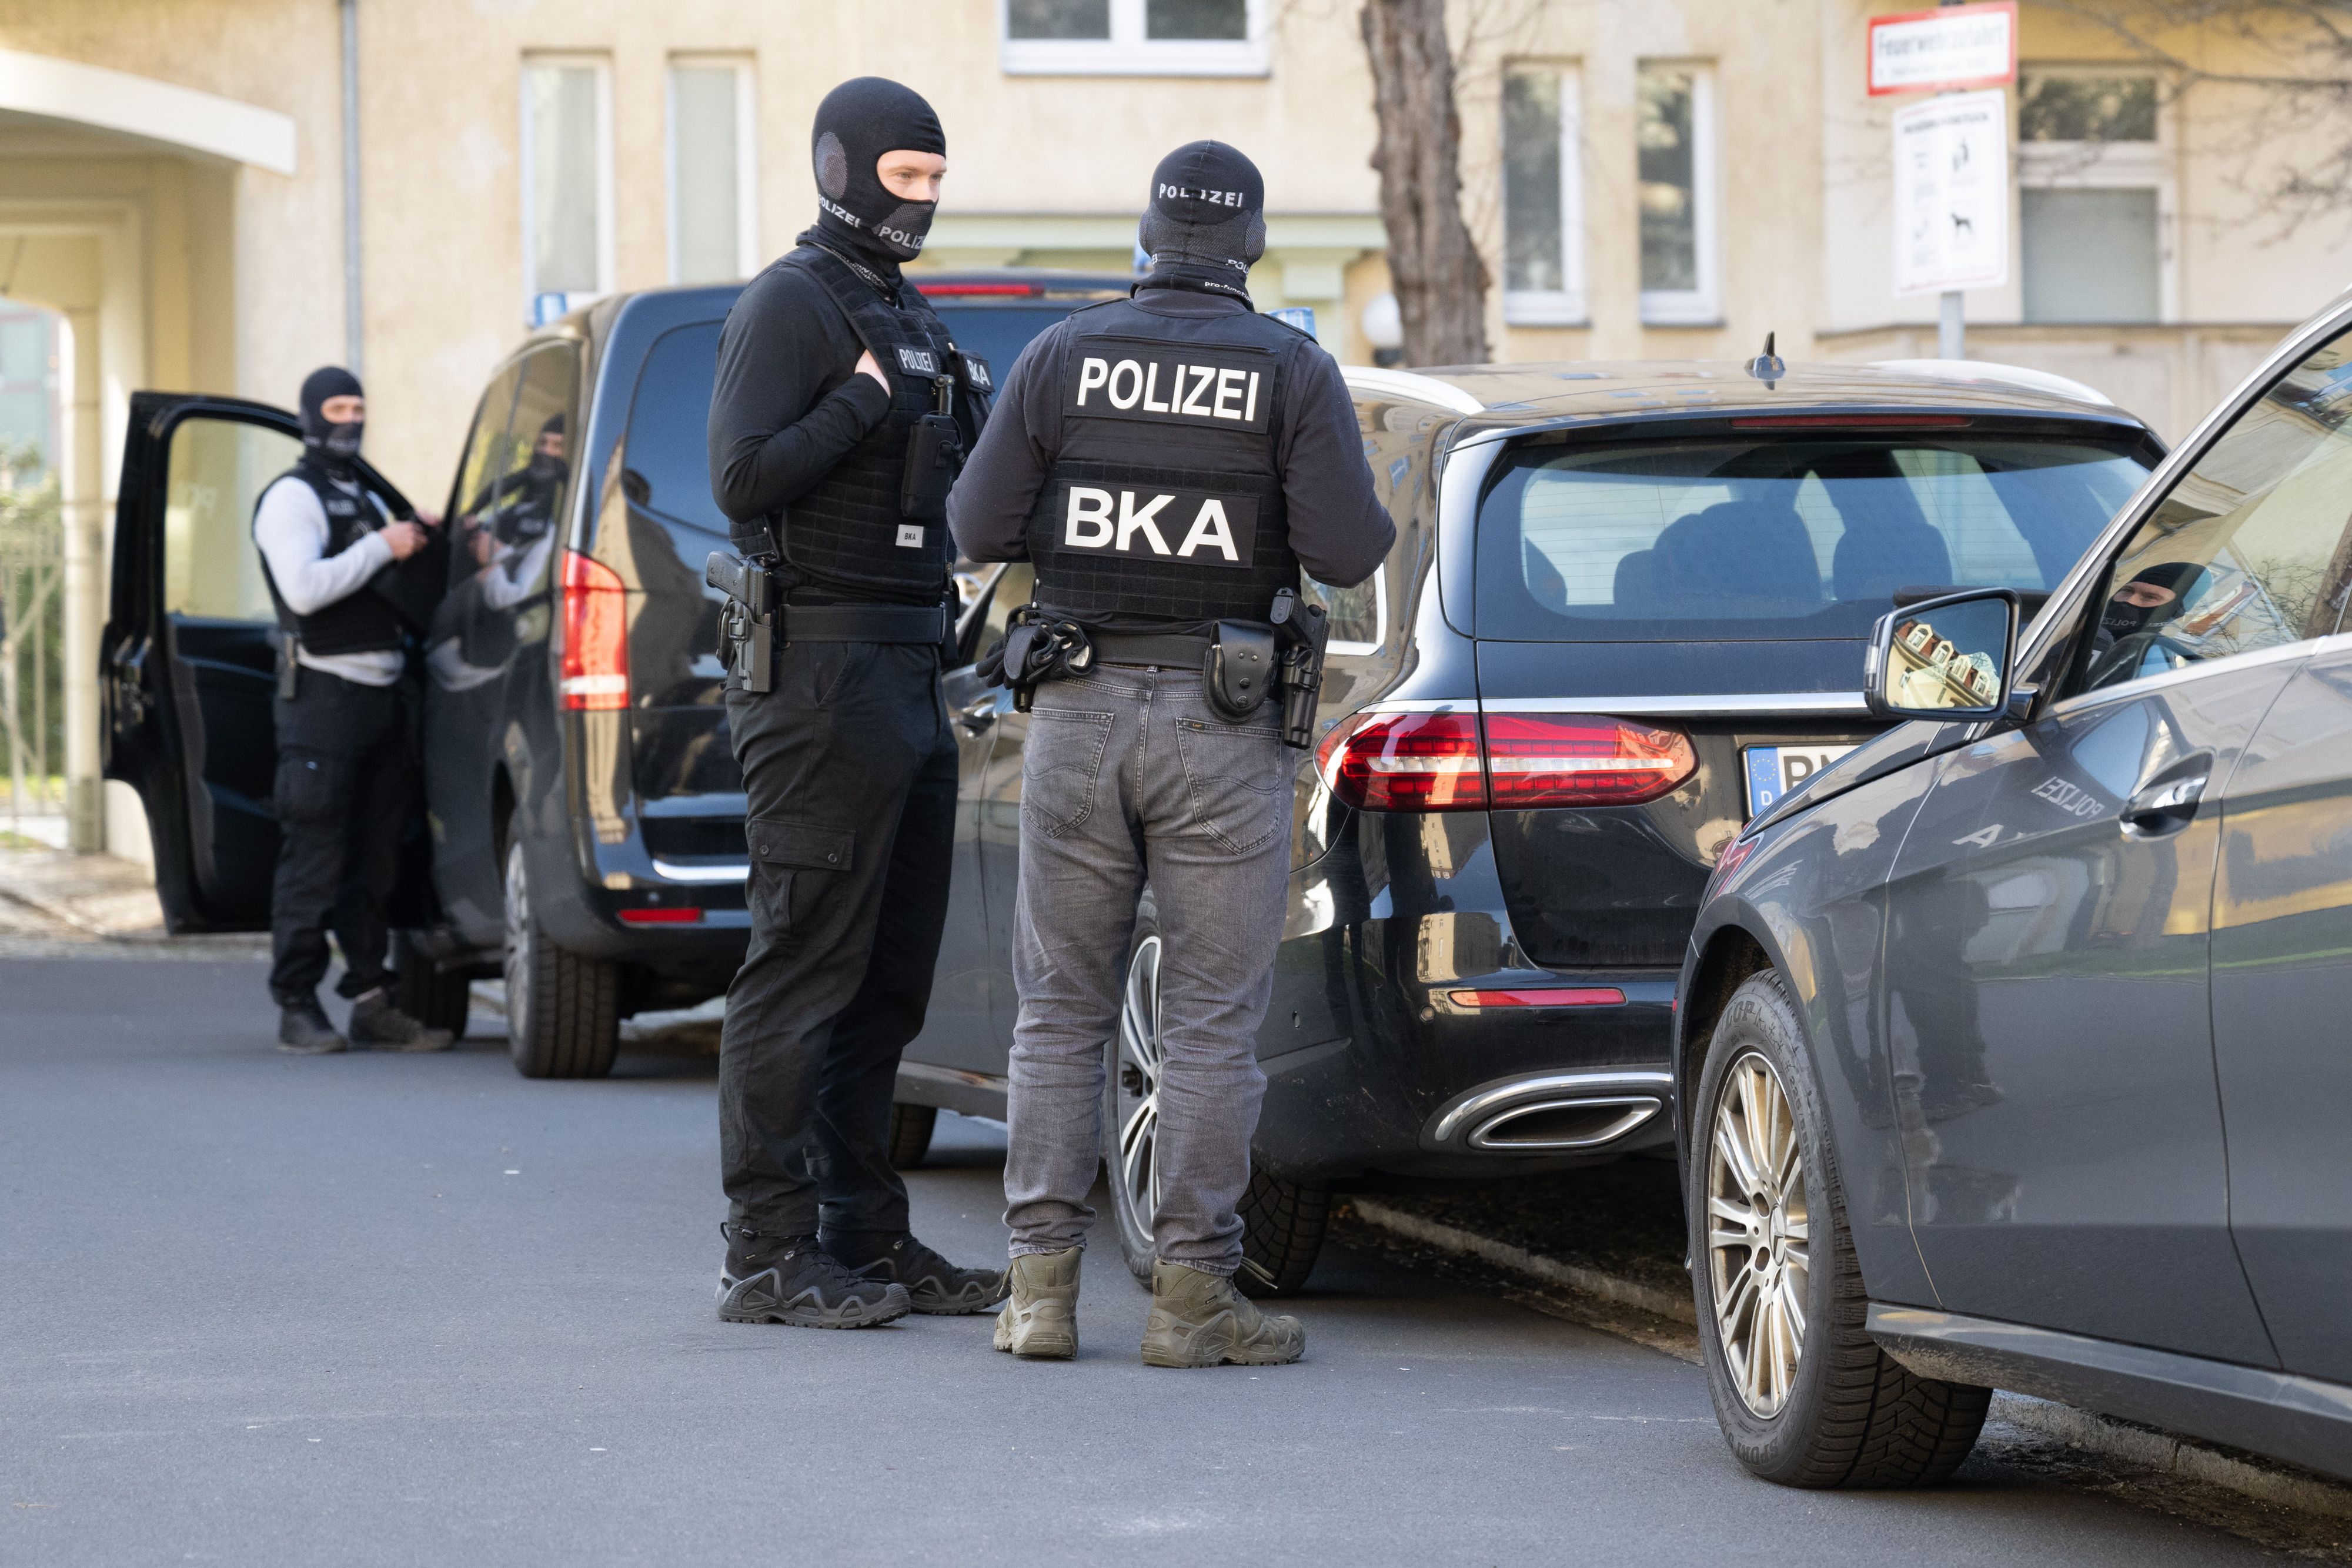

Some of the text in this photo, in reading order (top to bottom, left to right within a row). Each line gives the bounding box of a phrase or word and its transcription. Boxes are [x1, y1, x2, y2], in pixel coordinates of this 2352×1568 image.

[1159, 183, 1243, 208] POLIZEI
[878, 226, 927, 249] POLIZ
[1205, 281, 1252, 303] pro-function
[898, 349, 935, 373] POLIZEI
[967, 359, 990, 386] BKA
[1077, 357, 1259, 422] POLIZEI
[1065, 486, 1239, 561] BKA
[904, 532, 916, 541] BKA
[1760, 790, 1773, 806] D
